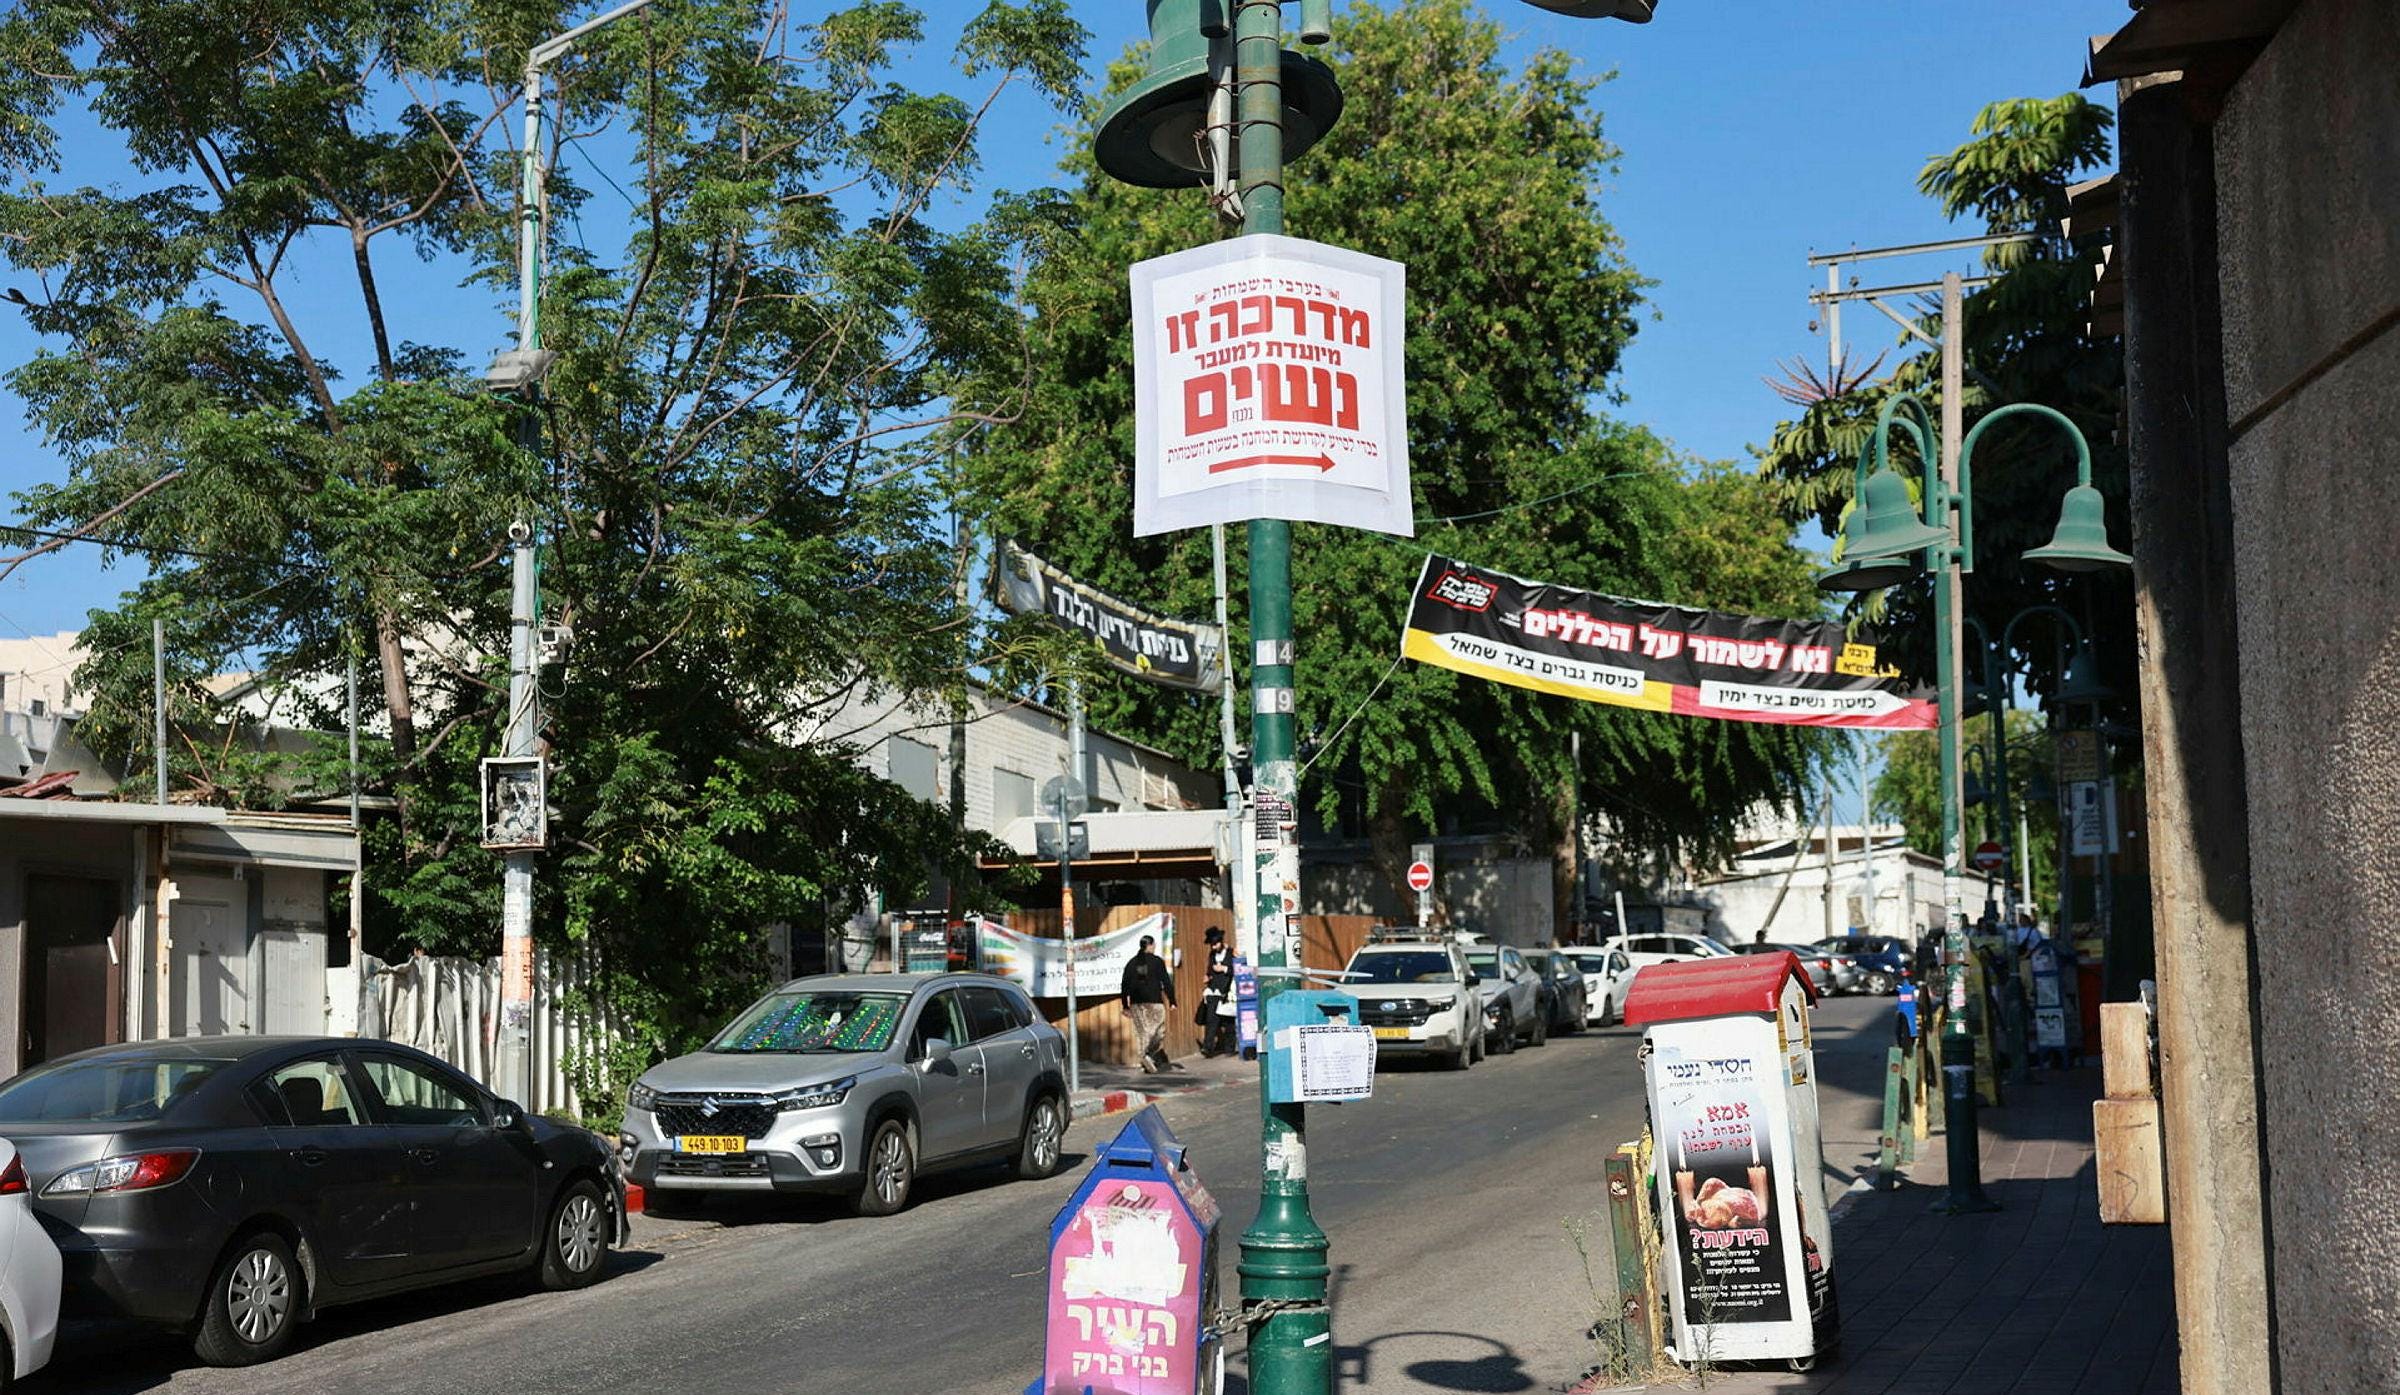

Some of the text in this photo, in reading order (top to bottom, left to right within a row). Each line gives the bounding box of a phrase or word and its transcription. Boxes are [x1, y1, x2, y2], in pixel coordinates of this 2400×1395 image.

[1213, 278, 1321, 300] בערבי השמחות
[1166, 295, 1370, 354] מדרכה זו
[1194, 341, 1342, 370] מיועדת למעבר
[1184, 363, 1359, 437] נשים
[1168, 441, 1205, 464] השמחות
[1523, 608, 1635, 652] הכללים
[1639, 623, 1683, 660] על
[1280, 642, 1292, 664] 4
[1450, 635, 1639, 689] כניסת גברים בצד שמאל
[1688, 637, 1786, 671] לשמור
[1792, 646, 1829, 674] נא
[1278, 690, 1292, 711] 9
[1719, 688, 1877, 710] כניסת נשים בצד ימין
[1667, 1063, 1701, 1078] נעמי
[1689, 1228, 1770, 1249] הידעת?
[1067, 1303, 1178, 1347] העיר
[1072, 1351, 1169, 1378] בני ברק
